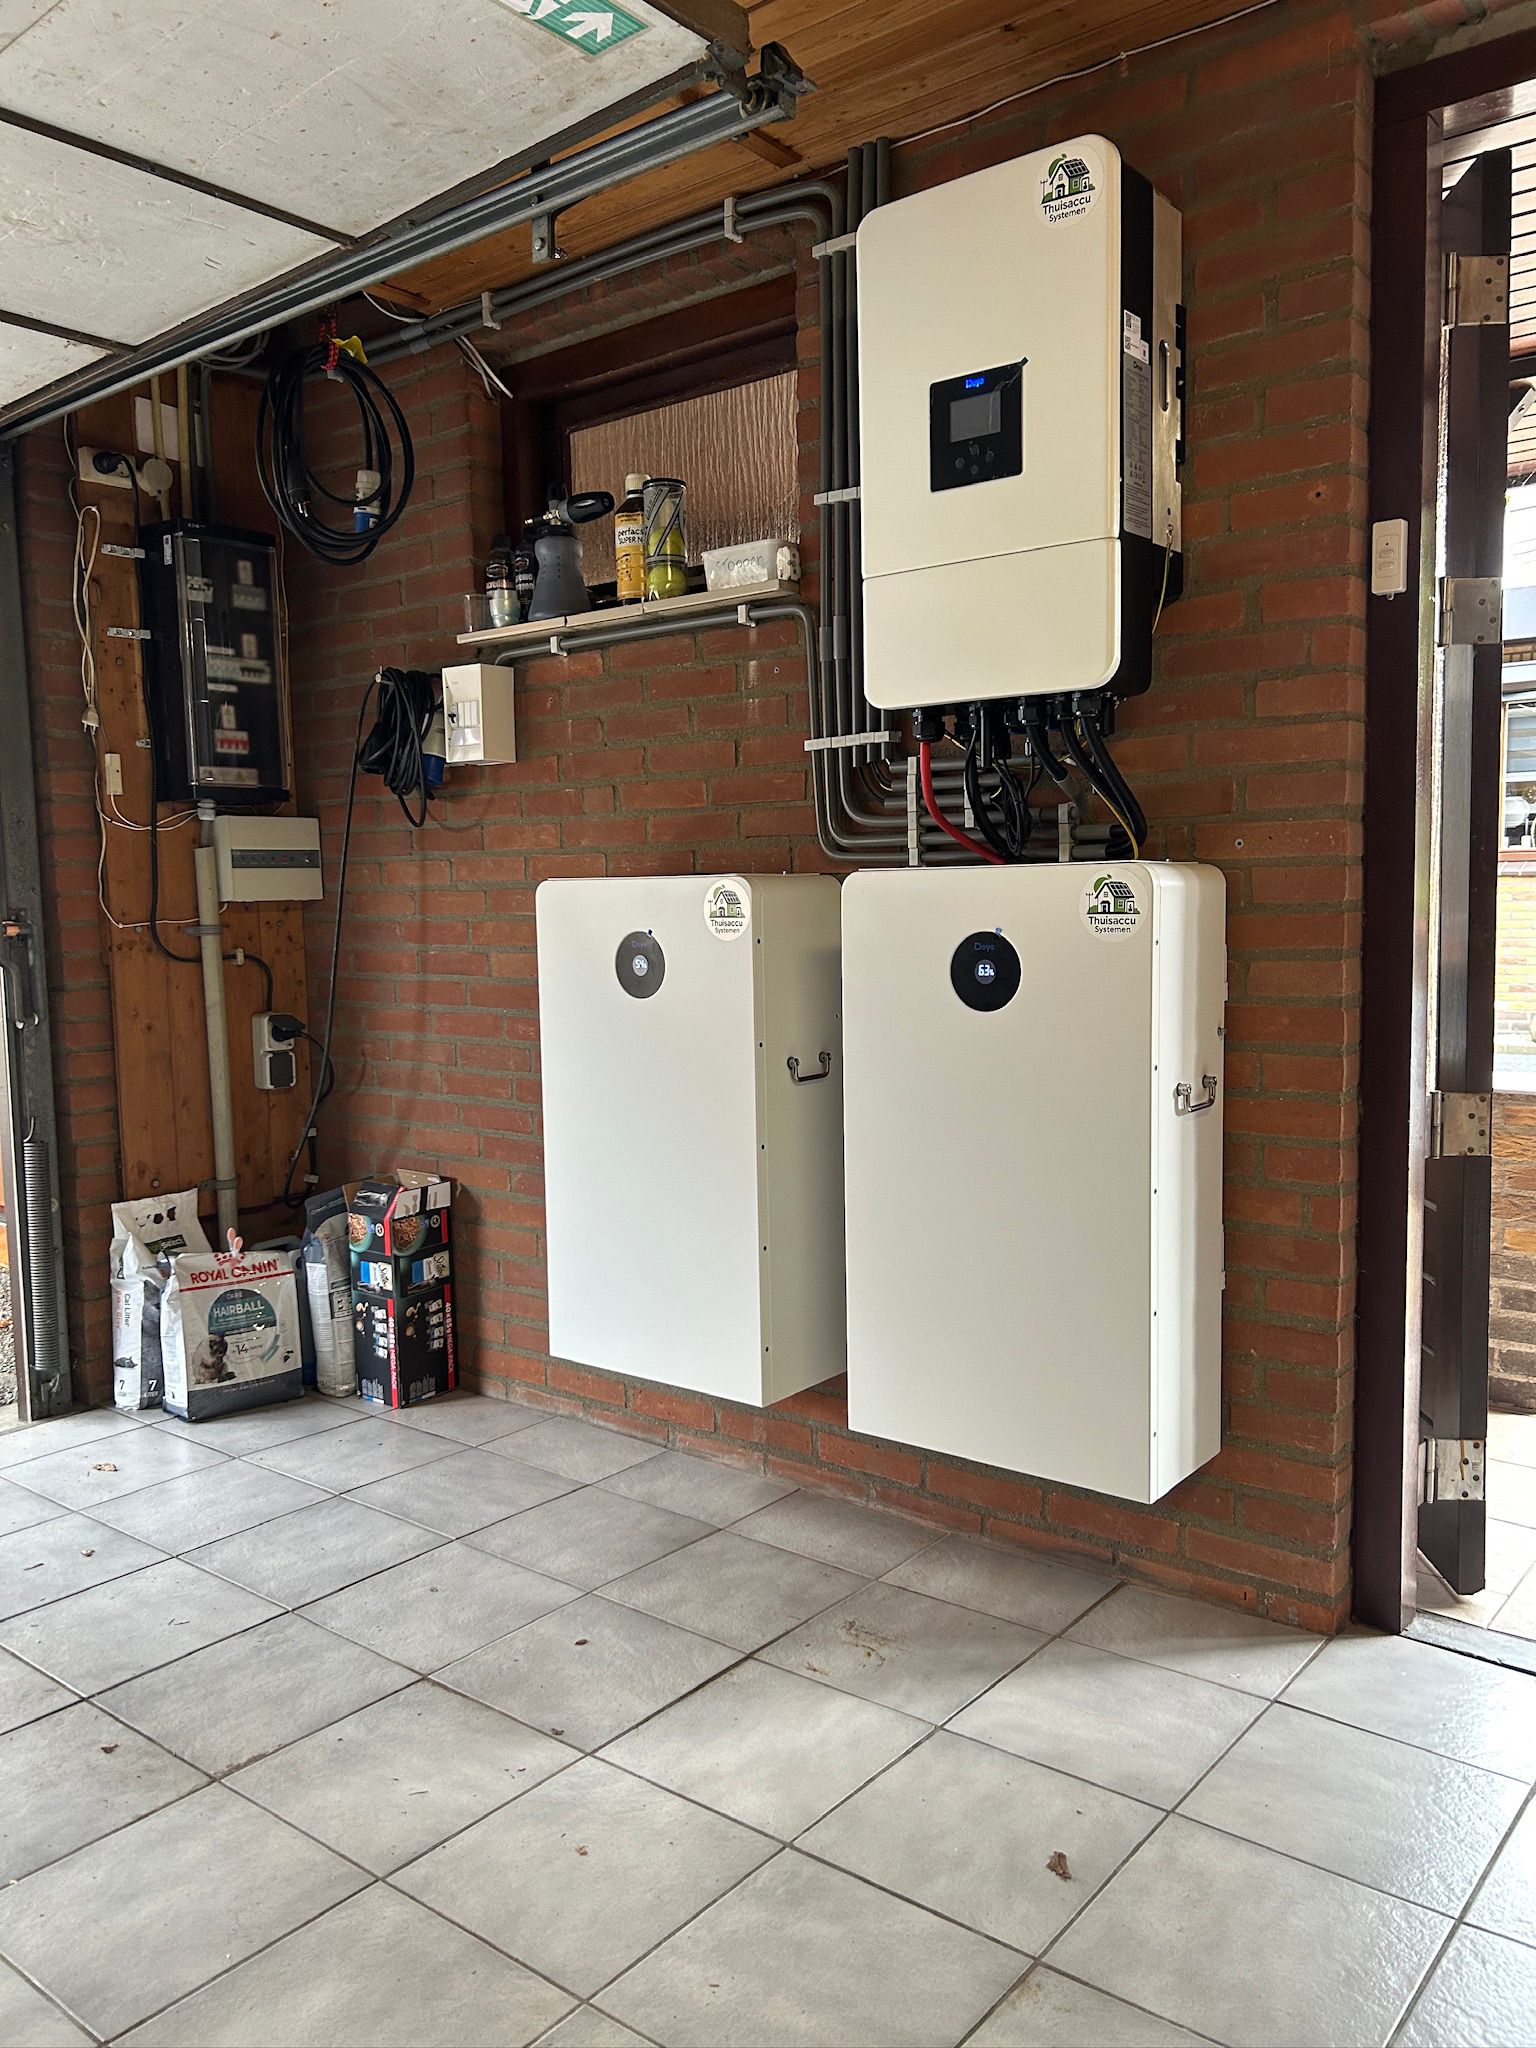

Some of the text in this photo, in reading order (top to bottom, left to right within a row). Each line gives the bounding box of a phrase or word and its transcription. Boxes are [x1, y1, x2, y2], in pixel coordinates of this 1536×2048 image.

[1043, 195, 1091, 215] Thuisaccu
[1049, 207, 1086, 222] Systemen
[710, 919, 743, 927] Thuisaccu
[1089, 916, 1136, 925] Thuisaccu
[1094, 925, 1131, 934] Systemen
[190, 1268, 229, 1284] ROYAL
[231, 1258, 278, 1278] CANIN
[213, 1300, 265, 1318] HAIRBALL
[235, 1343, 249, 1355] 14
[119, 1379, 125, 1390] 7
[148, 1379, 157, 1391] 7
